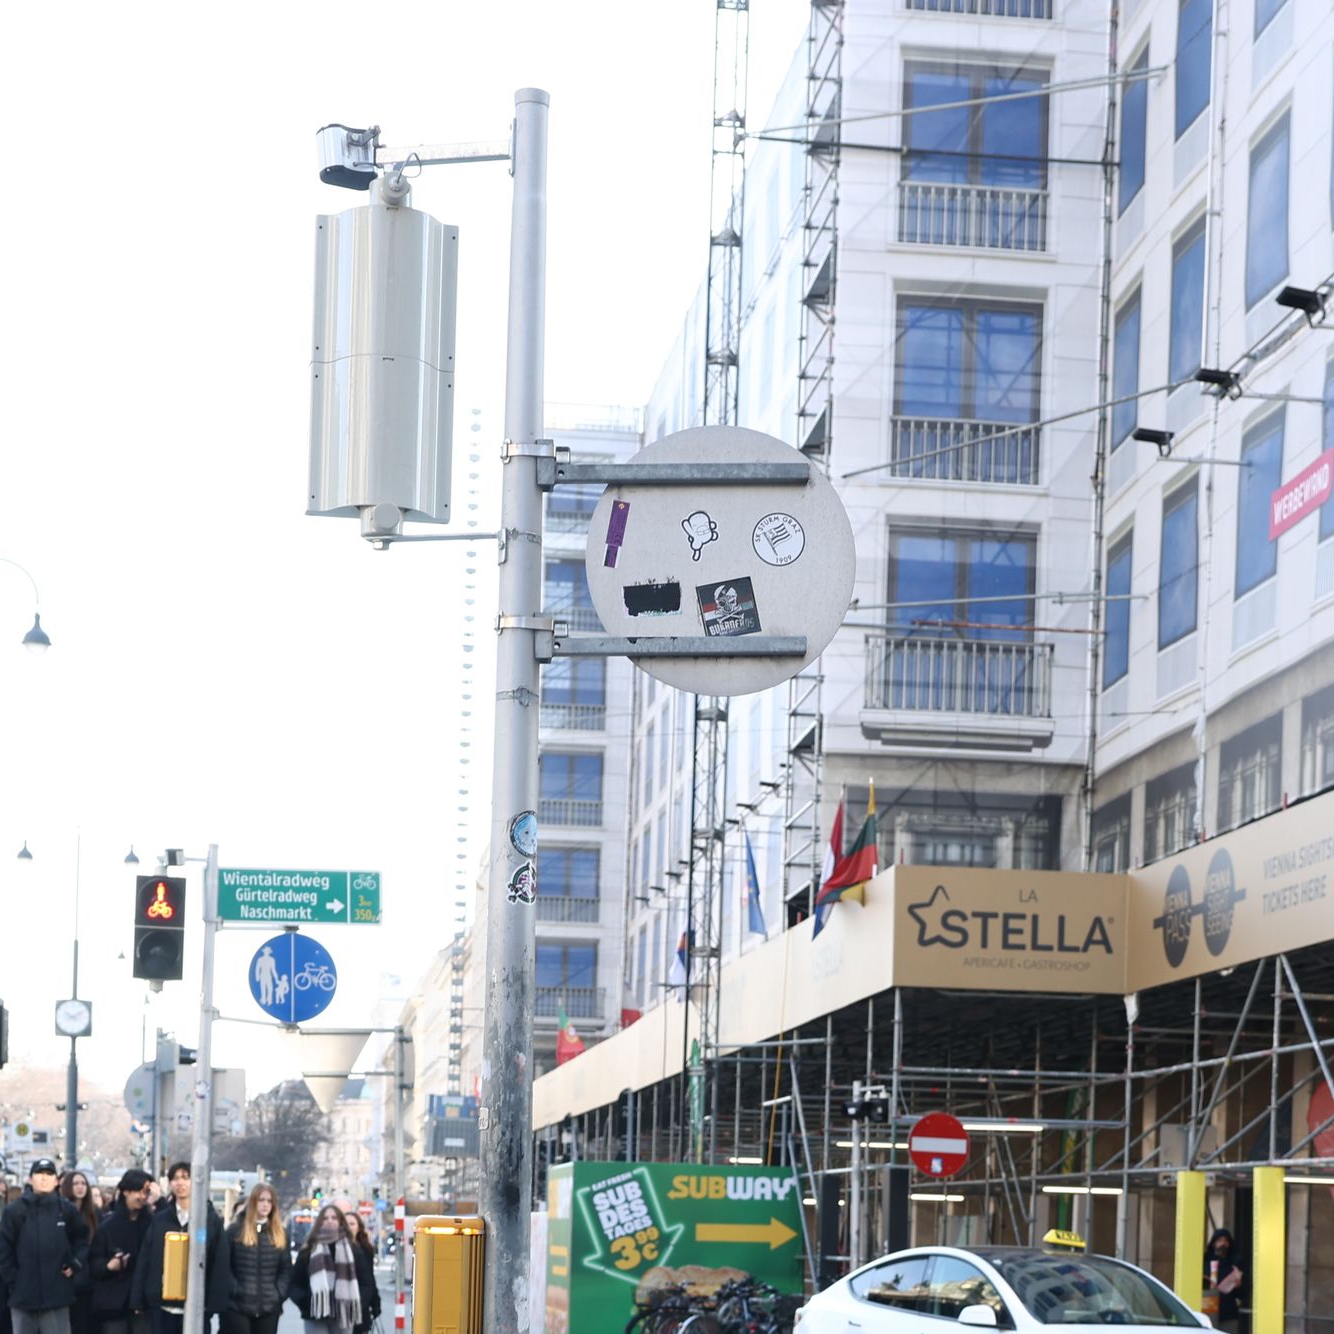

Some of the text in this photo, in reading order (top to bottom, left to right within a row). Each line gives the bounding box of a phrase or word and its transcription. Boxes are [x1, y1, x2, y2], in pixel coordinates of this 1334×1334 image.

[223, 872, 330, 890] Wientalradweg
[235, 887, 317, 905] Gürtelradweg
[1019, 889, 1038, 903] LA
[240, 905, 312, 920] Naschmarkt
[940, 909, 1114, 954] STELLA
[593, 1180, 643, 1212] SUB
[667, 1175, 797, 1200] SUBWAY
[598, 1198, 648, 1230] DES
[604, 1217, 653, 1241] TAGES
